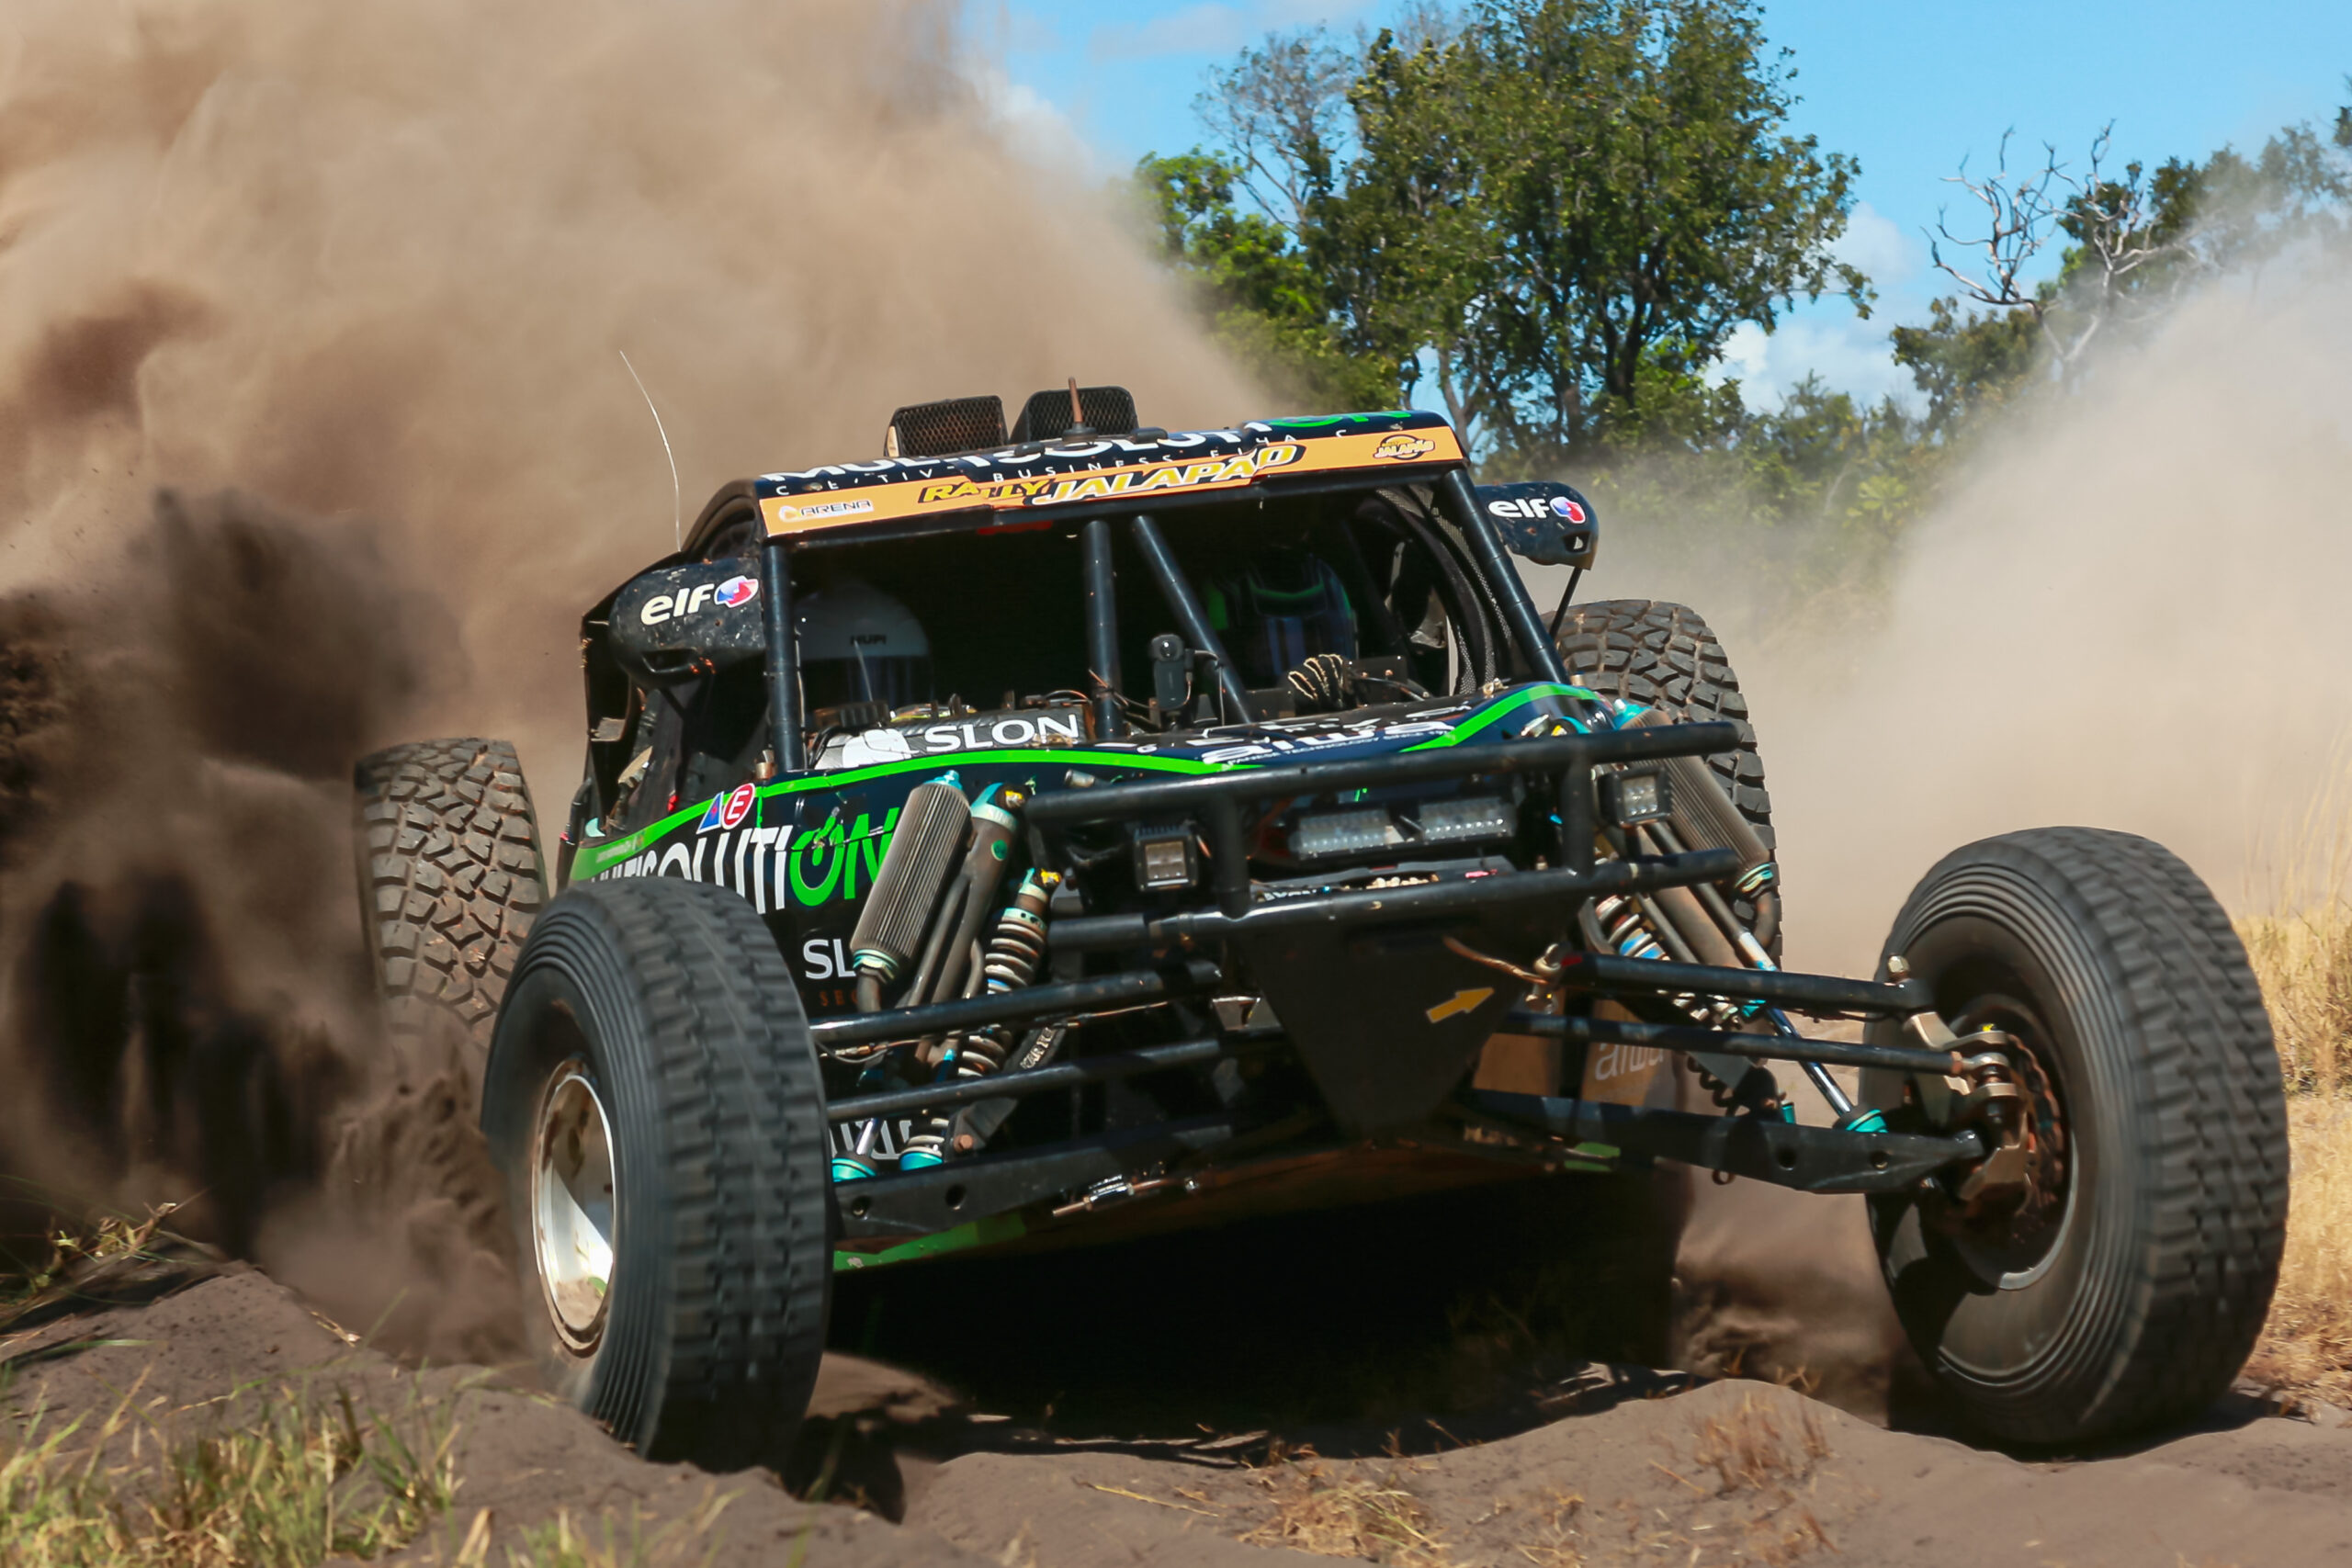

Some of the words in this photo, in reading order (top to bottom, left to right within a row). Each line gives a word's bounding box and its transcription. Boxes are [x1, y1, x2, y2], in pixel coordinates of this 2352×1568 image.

[922, 479, 1050, 503] RALLY
[1033, 445, 1297, 505] JALAPÃO
[992, 454, 1174, 483] BUSINESS
[800, 499, 873, 516] ARENA
[1488, 499, 1549, 519] elf
[640, 583, 714, 626] elf
[924, 714, 1079, 752] SLON
[728, 790, 749, 819] E
